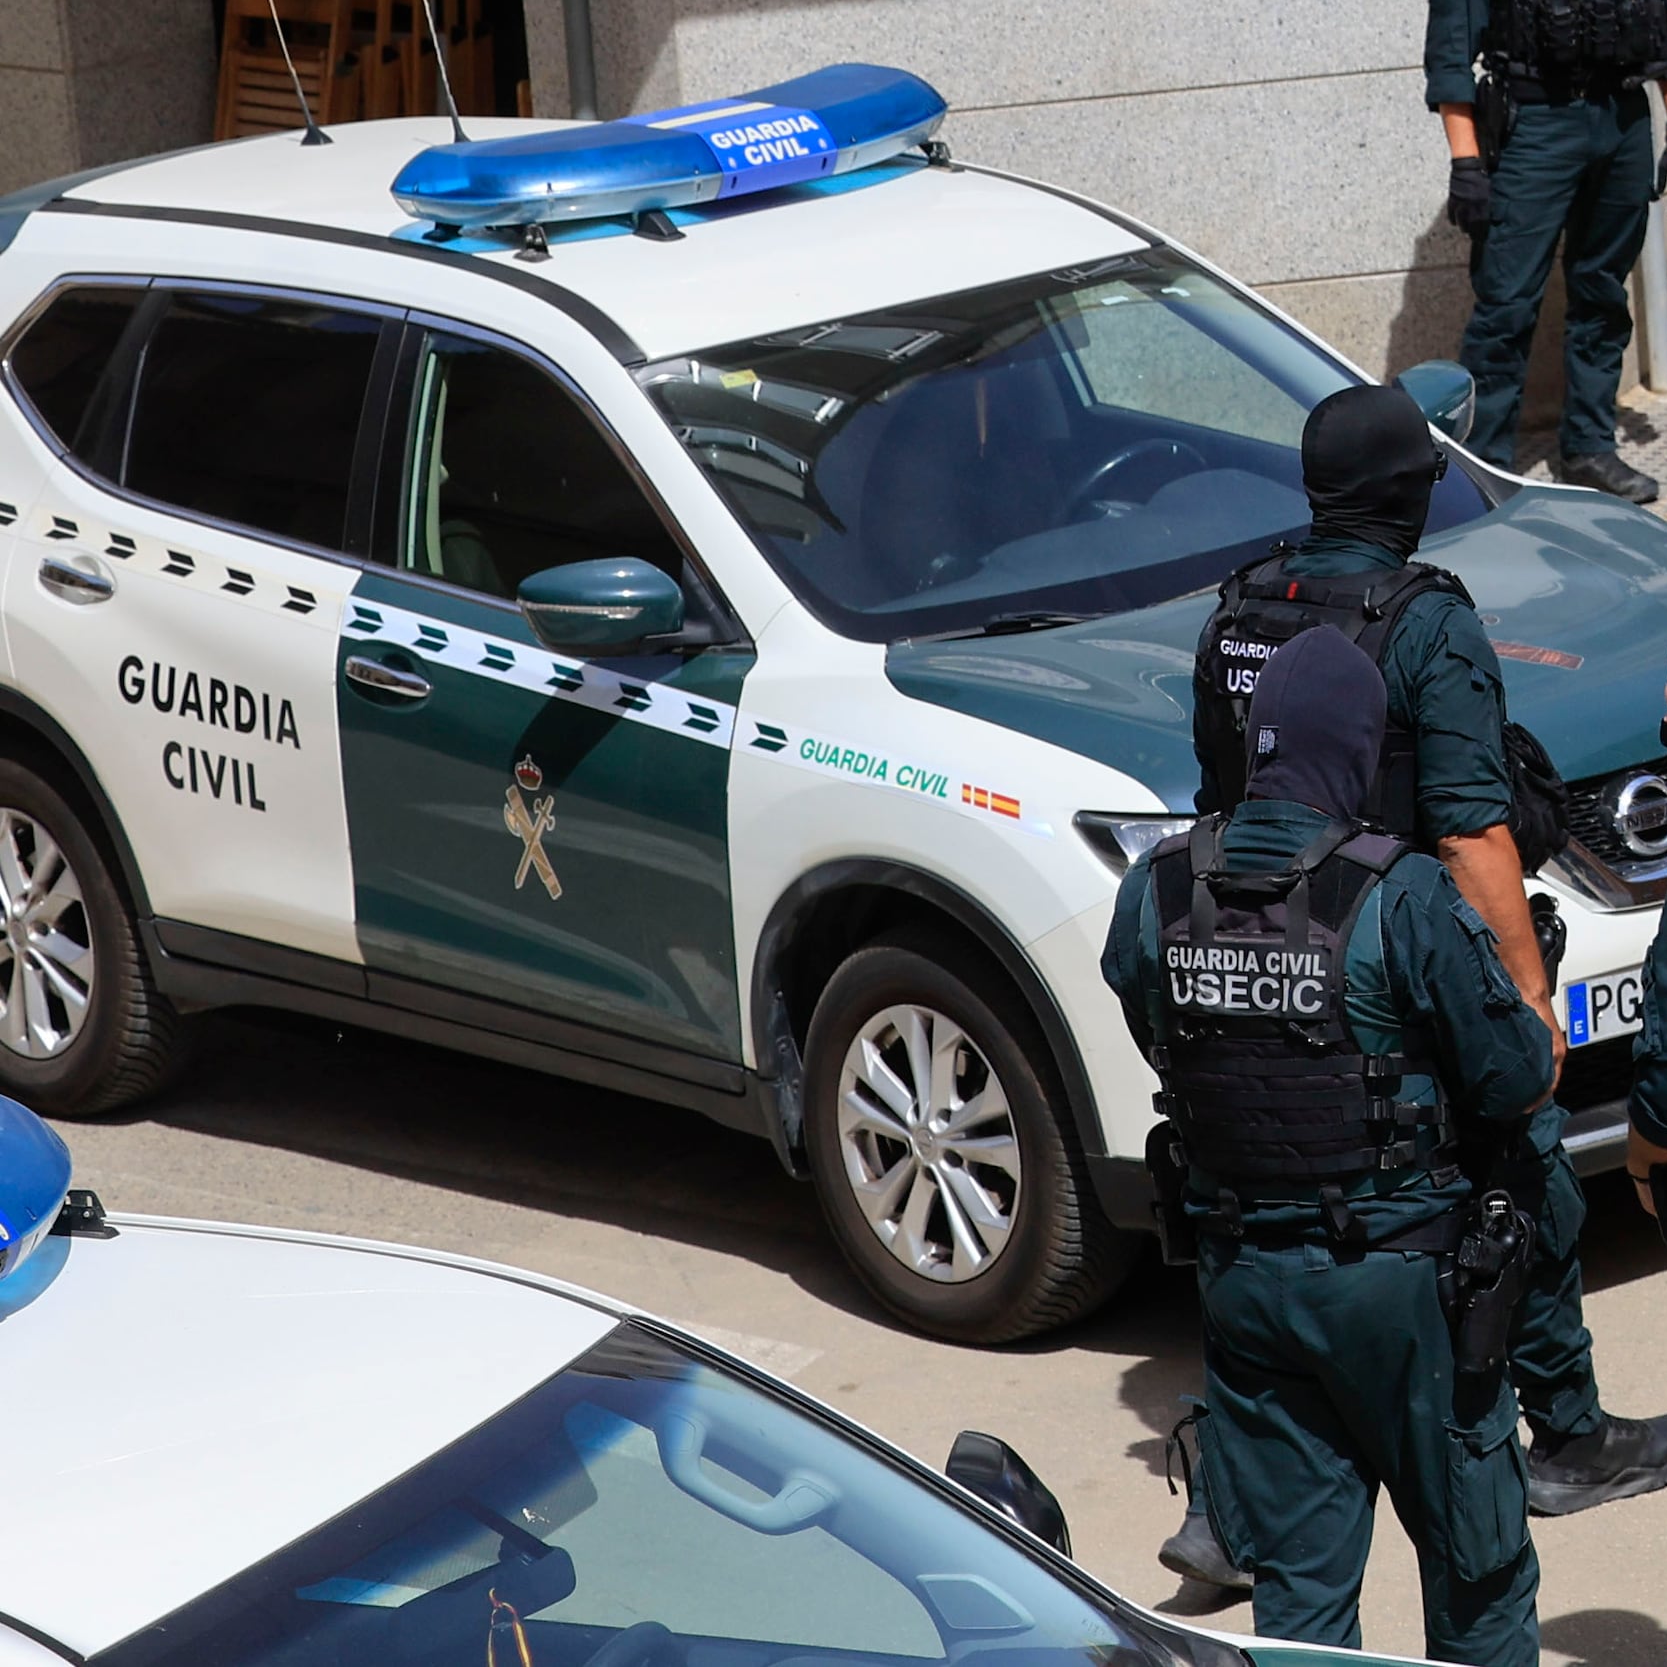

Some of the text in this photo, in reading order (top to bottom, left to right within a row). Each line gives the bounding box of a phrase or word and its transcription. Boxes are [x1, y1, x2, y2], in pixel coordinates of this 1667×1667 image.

[710, 115, 819, 149] GUARDIA
[744, 137, 809, 165] CIVIL
[118, 654, 301, 750] GUARDIA
[163, 741, 266, 812] CIVIL
[800, 738, 949, 798] GUARDIA CIVIL
[1167, 946, 1326, 977] GUARDIA CIVIL
[1170, 972, 1324, 1014] USECIC
[1574, 1020, 1583, 1035] E
